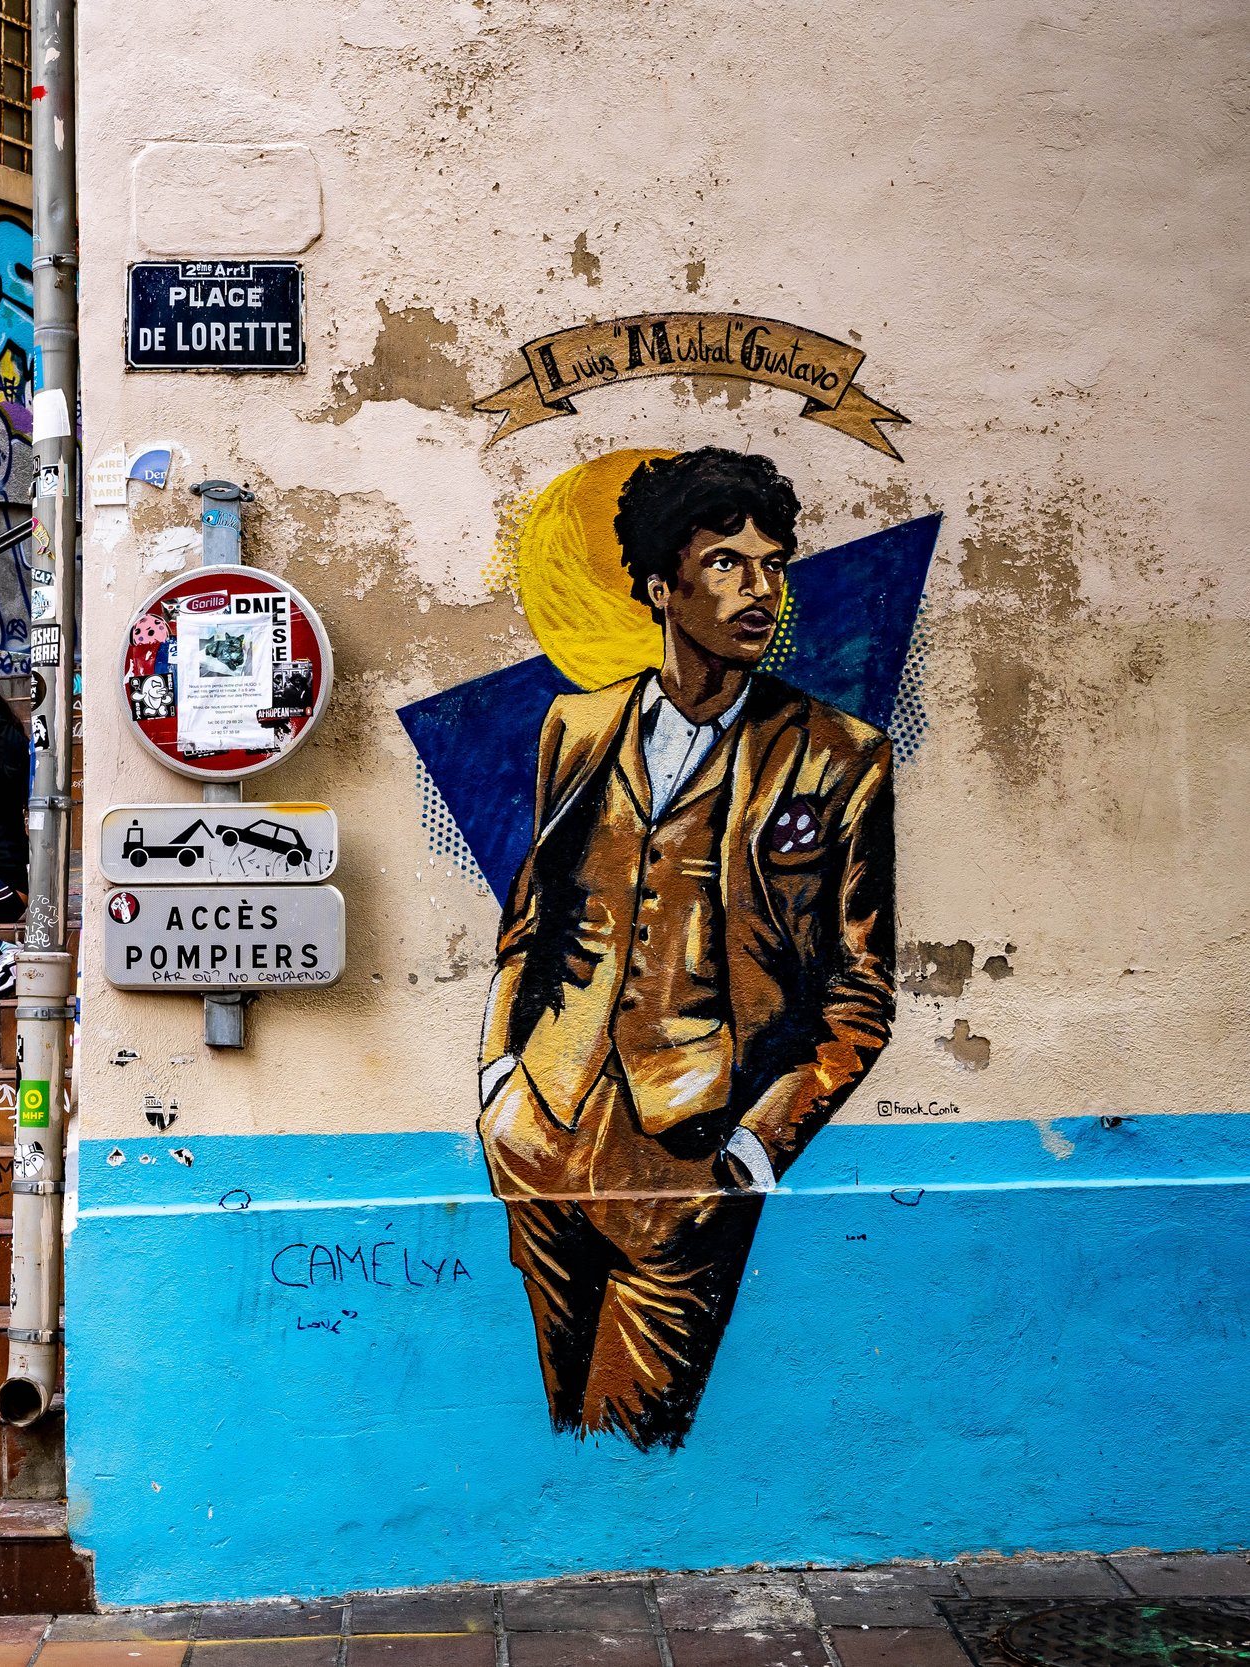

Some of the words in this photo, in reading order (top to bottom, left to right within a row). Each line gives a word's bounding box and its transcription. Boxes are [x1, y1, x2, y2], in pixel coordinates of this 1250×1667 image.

[169, 287, 264, 308] PLACE
[140, 327, 166, 351] DE
[177, 322, 292, 351] LORETTE
[741, 325, 839, 393] Gustavo
[191, 597, 225, 610] Gorilla
[258, 707, 290, 718] AFROPEAN
[166, 899, 278, 930] ACCÈS
[126, 943, 319, 970] POMPIERS
[152, 971, 186, 983] PAR
[229, 972, 249, 983] NO
[22, 1111, 44, 1120] MHF
